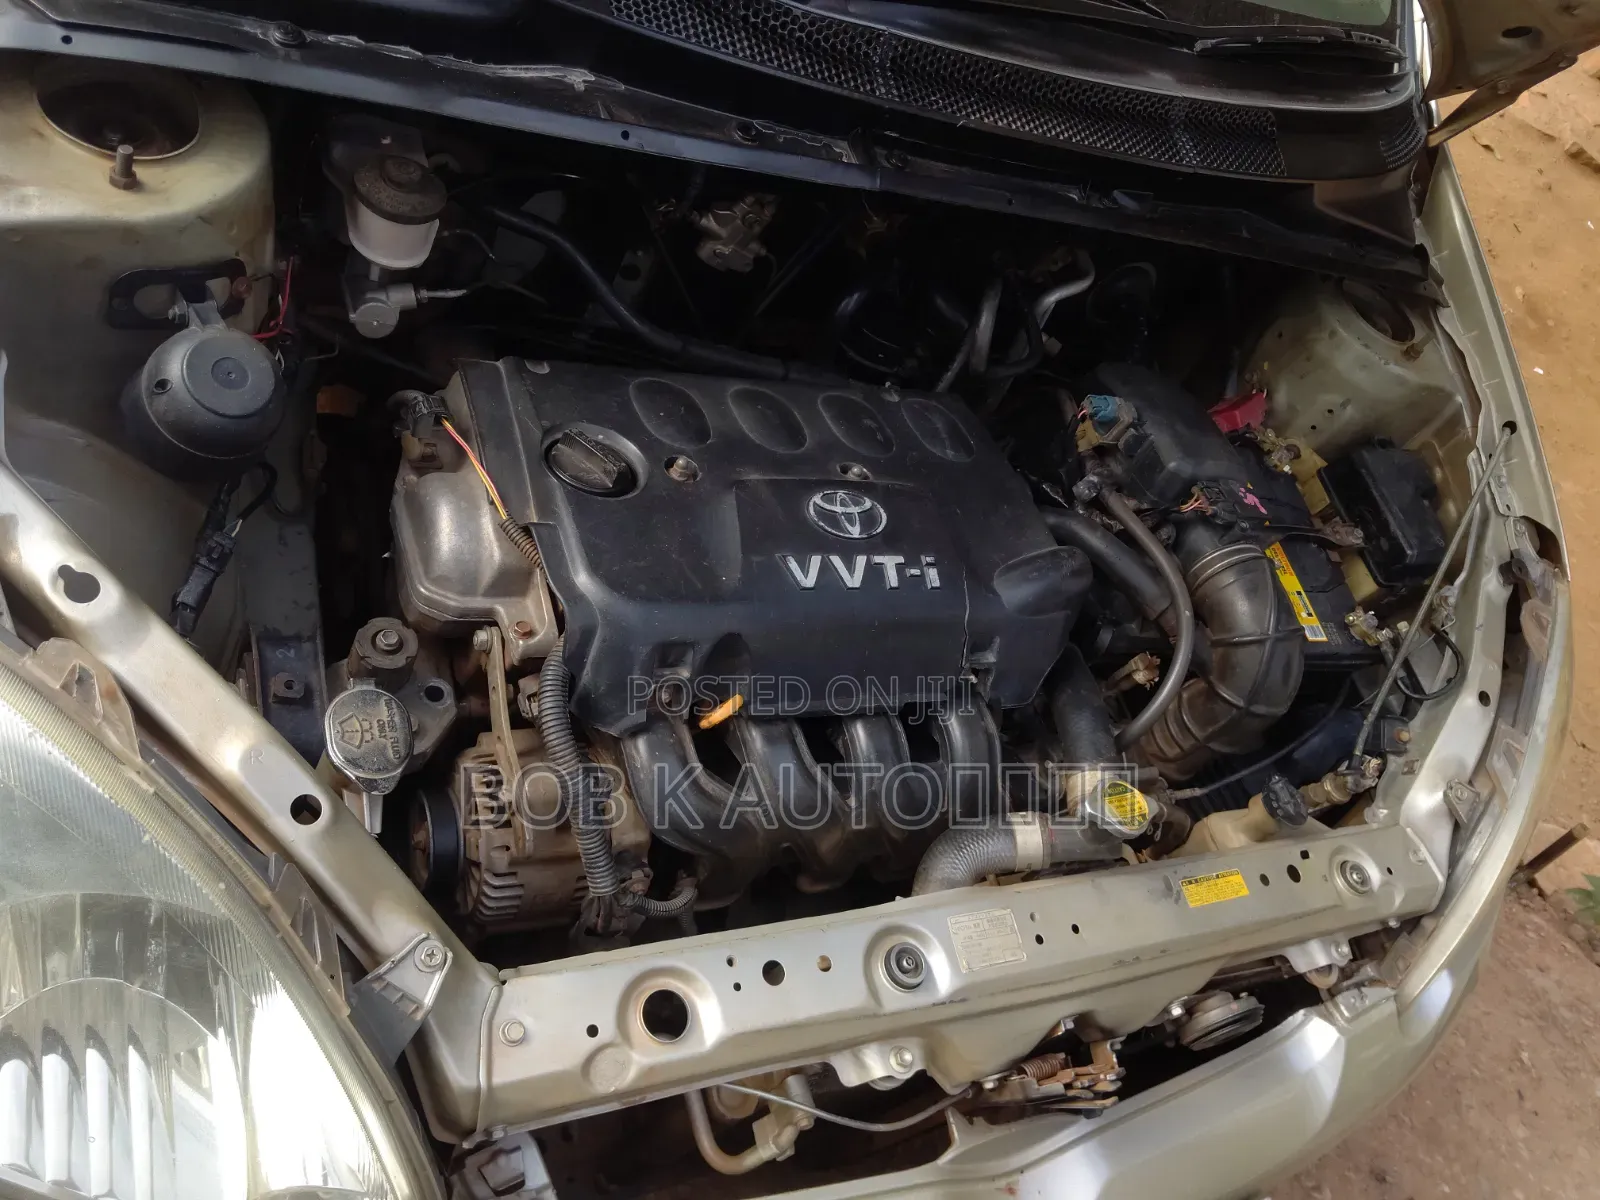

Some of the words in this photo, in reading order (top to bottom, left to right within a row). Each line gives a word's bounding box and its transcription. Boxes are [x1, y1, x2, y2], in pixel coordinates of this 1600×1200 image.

[775, 553, 941, 591] VVT-i
[376, 718, 388, 741] ONLY
[384, 699, 397, 732] WASHER
[389, 736, 401, 760] FLUID
